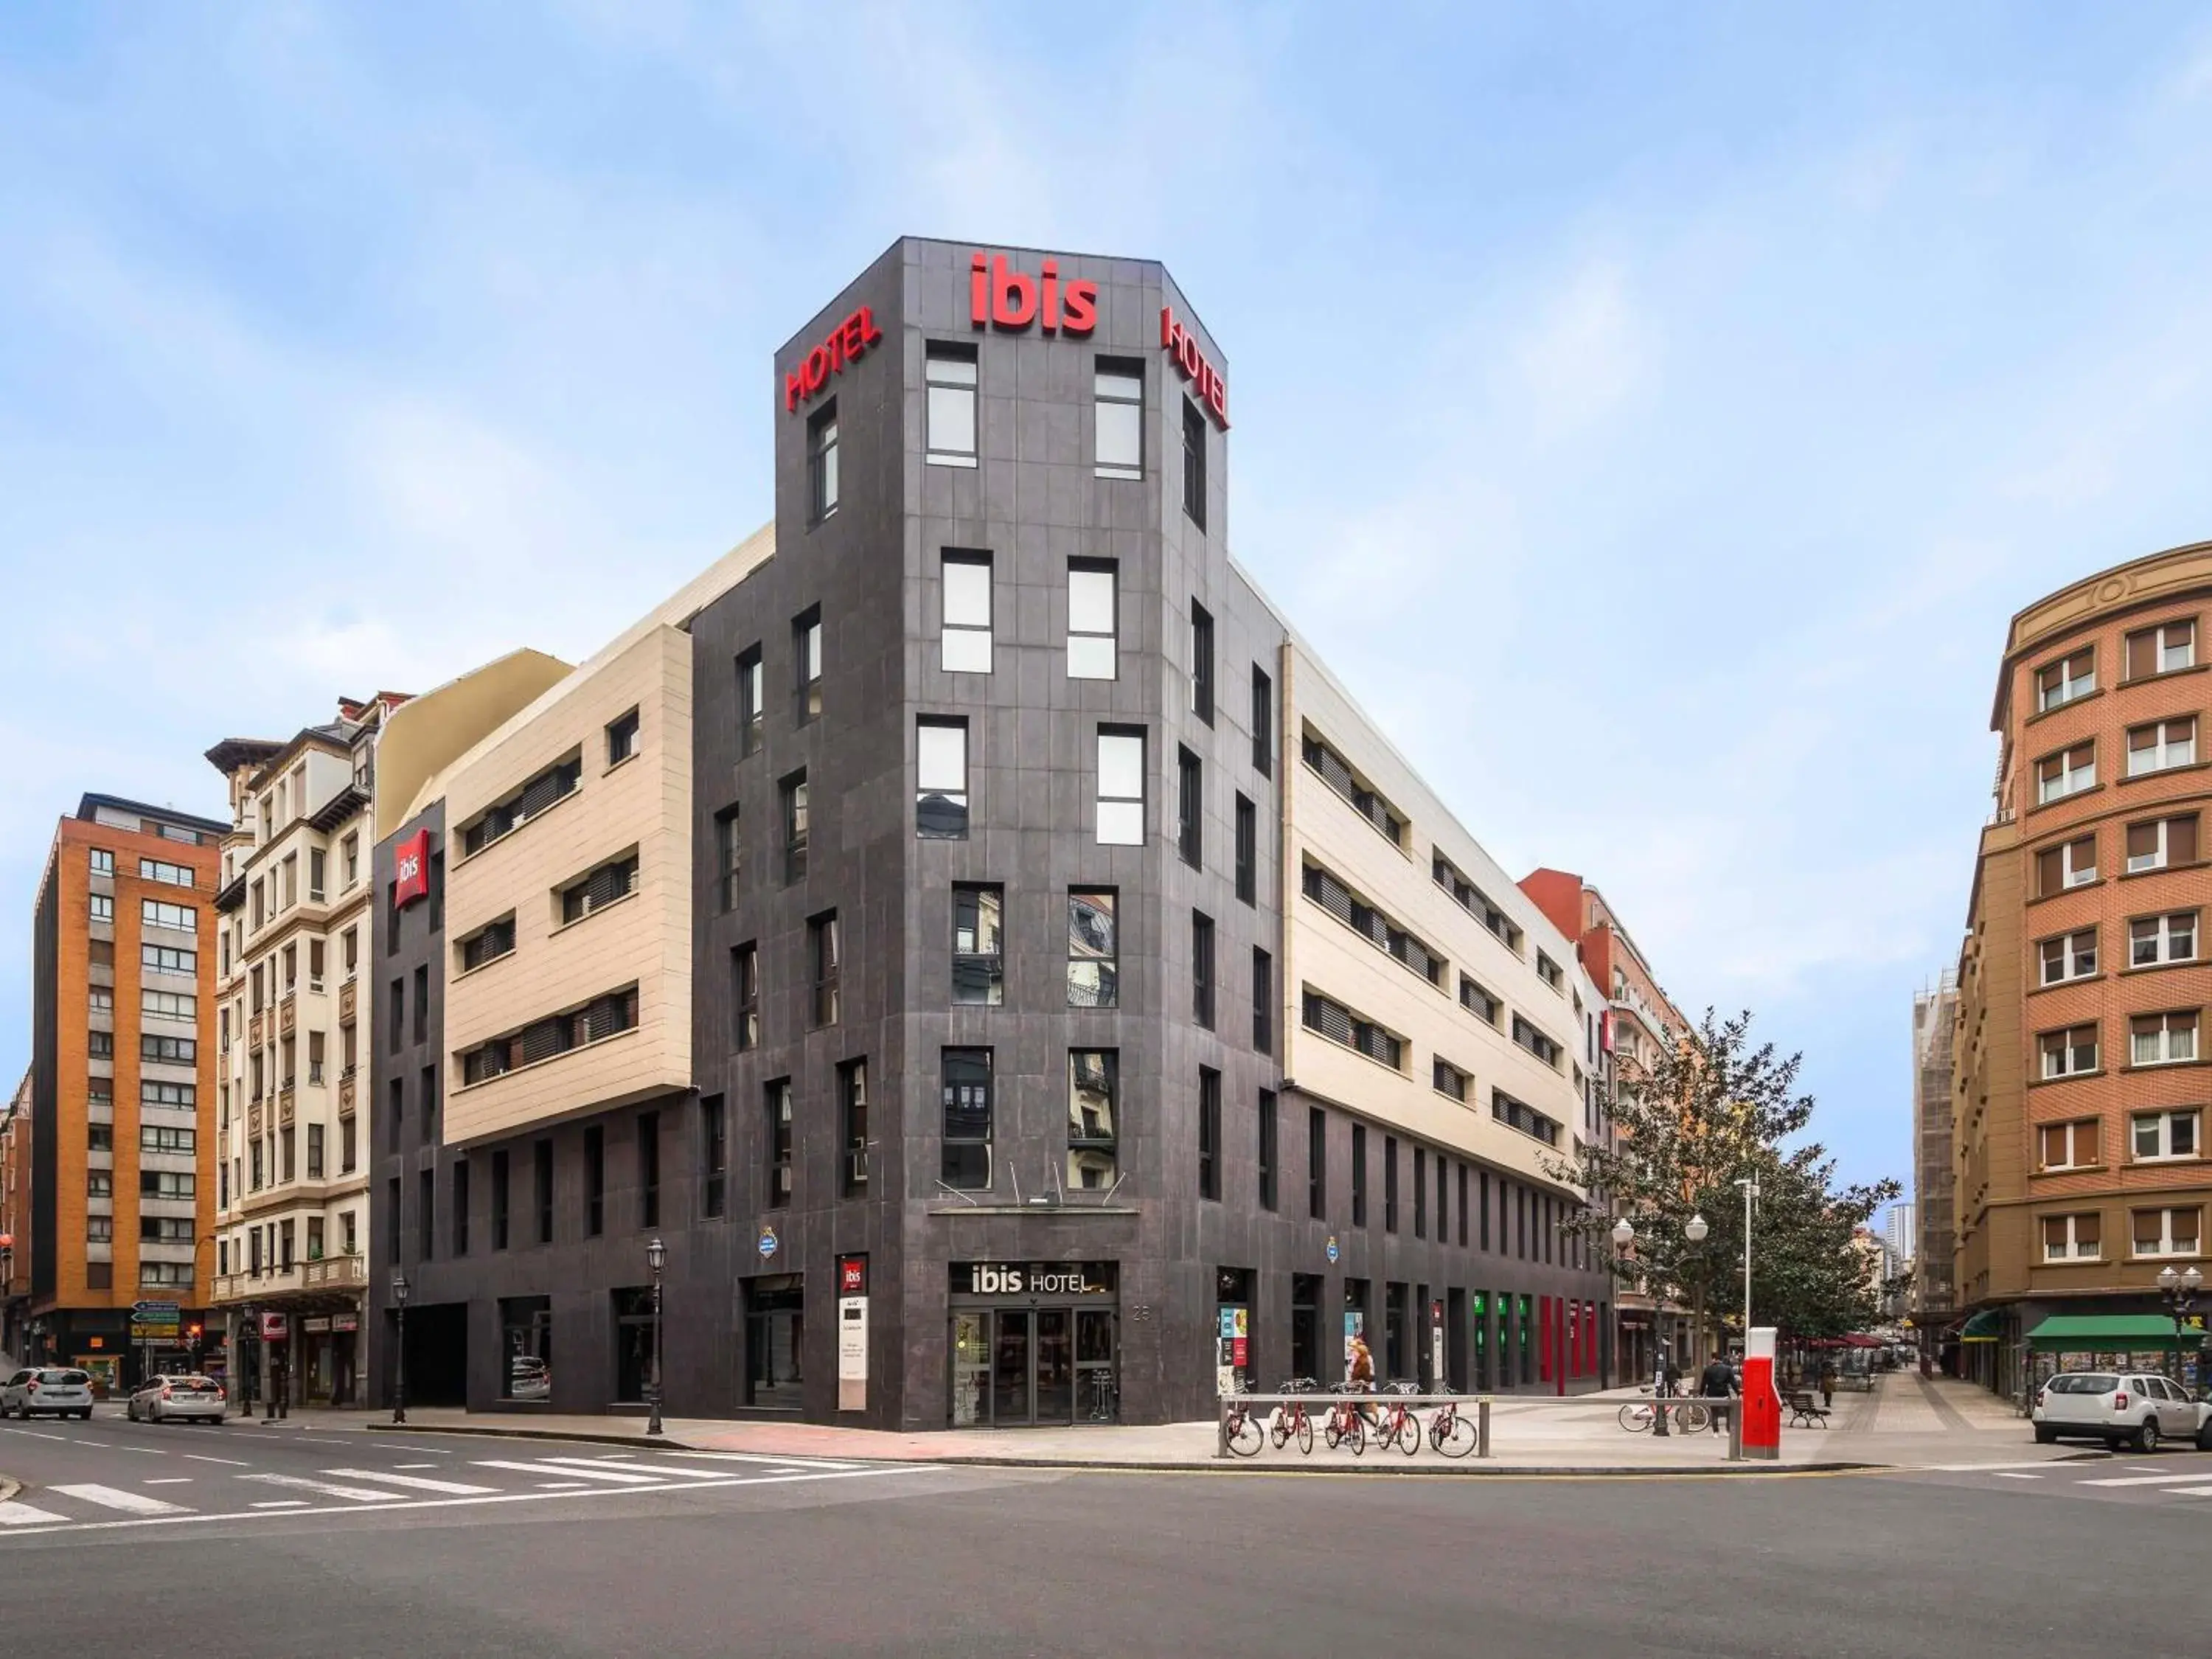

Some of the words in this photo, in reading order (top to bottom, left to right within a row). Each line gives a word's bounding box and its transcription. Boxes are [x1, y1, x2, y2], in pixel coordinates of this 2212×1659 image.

[970, 251, 1099, 334] ibis
[785, 305, 883, 414] HOTEL
[1160, 306, 1231, 431] HOTEL
[400, 854, 418, 883] ibis
[845, 1268, 861, 1282] ibis
[973, 1265, 1023, 1293] ibis
[1030, 1274, 1092, 1293] HOTEL
